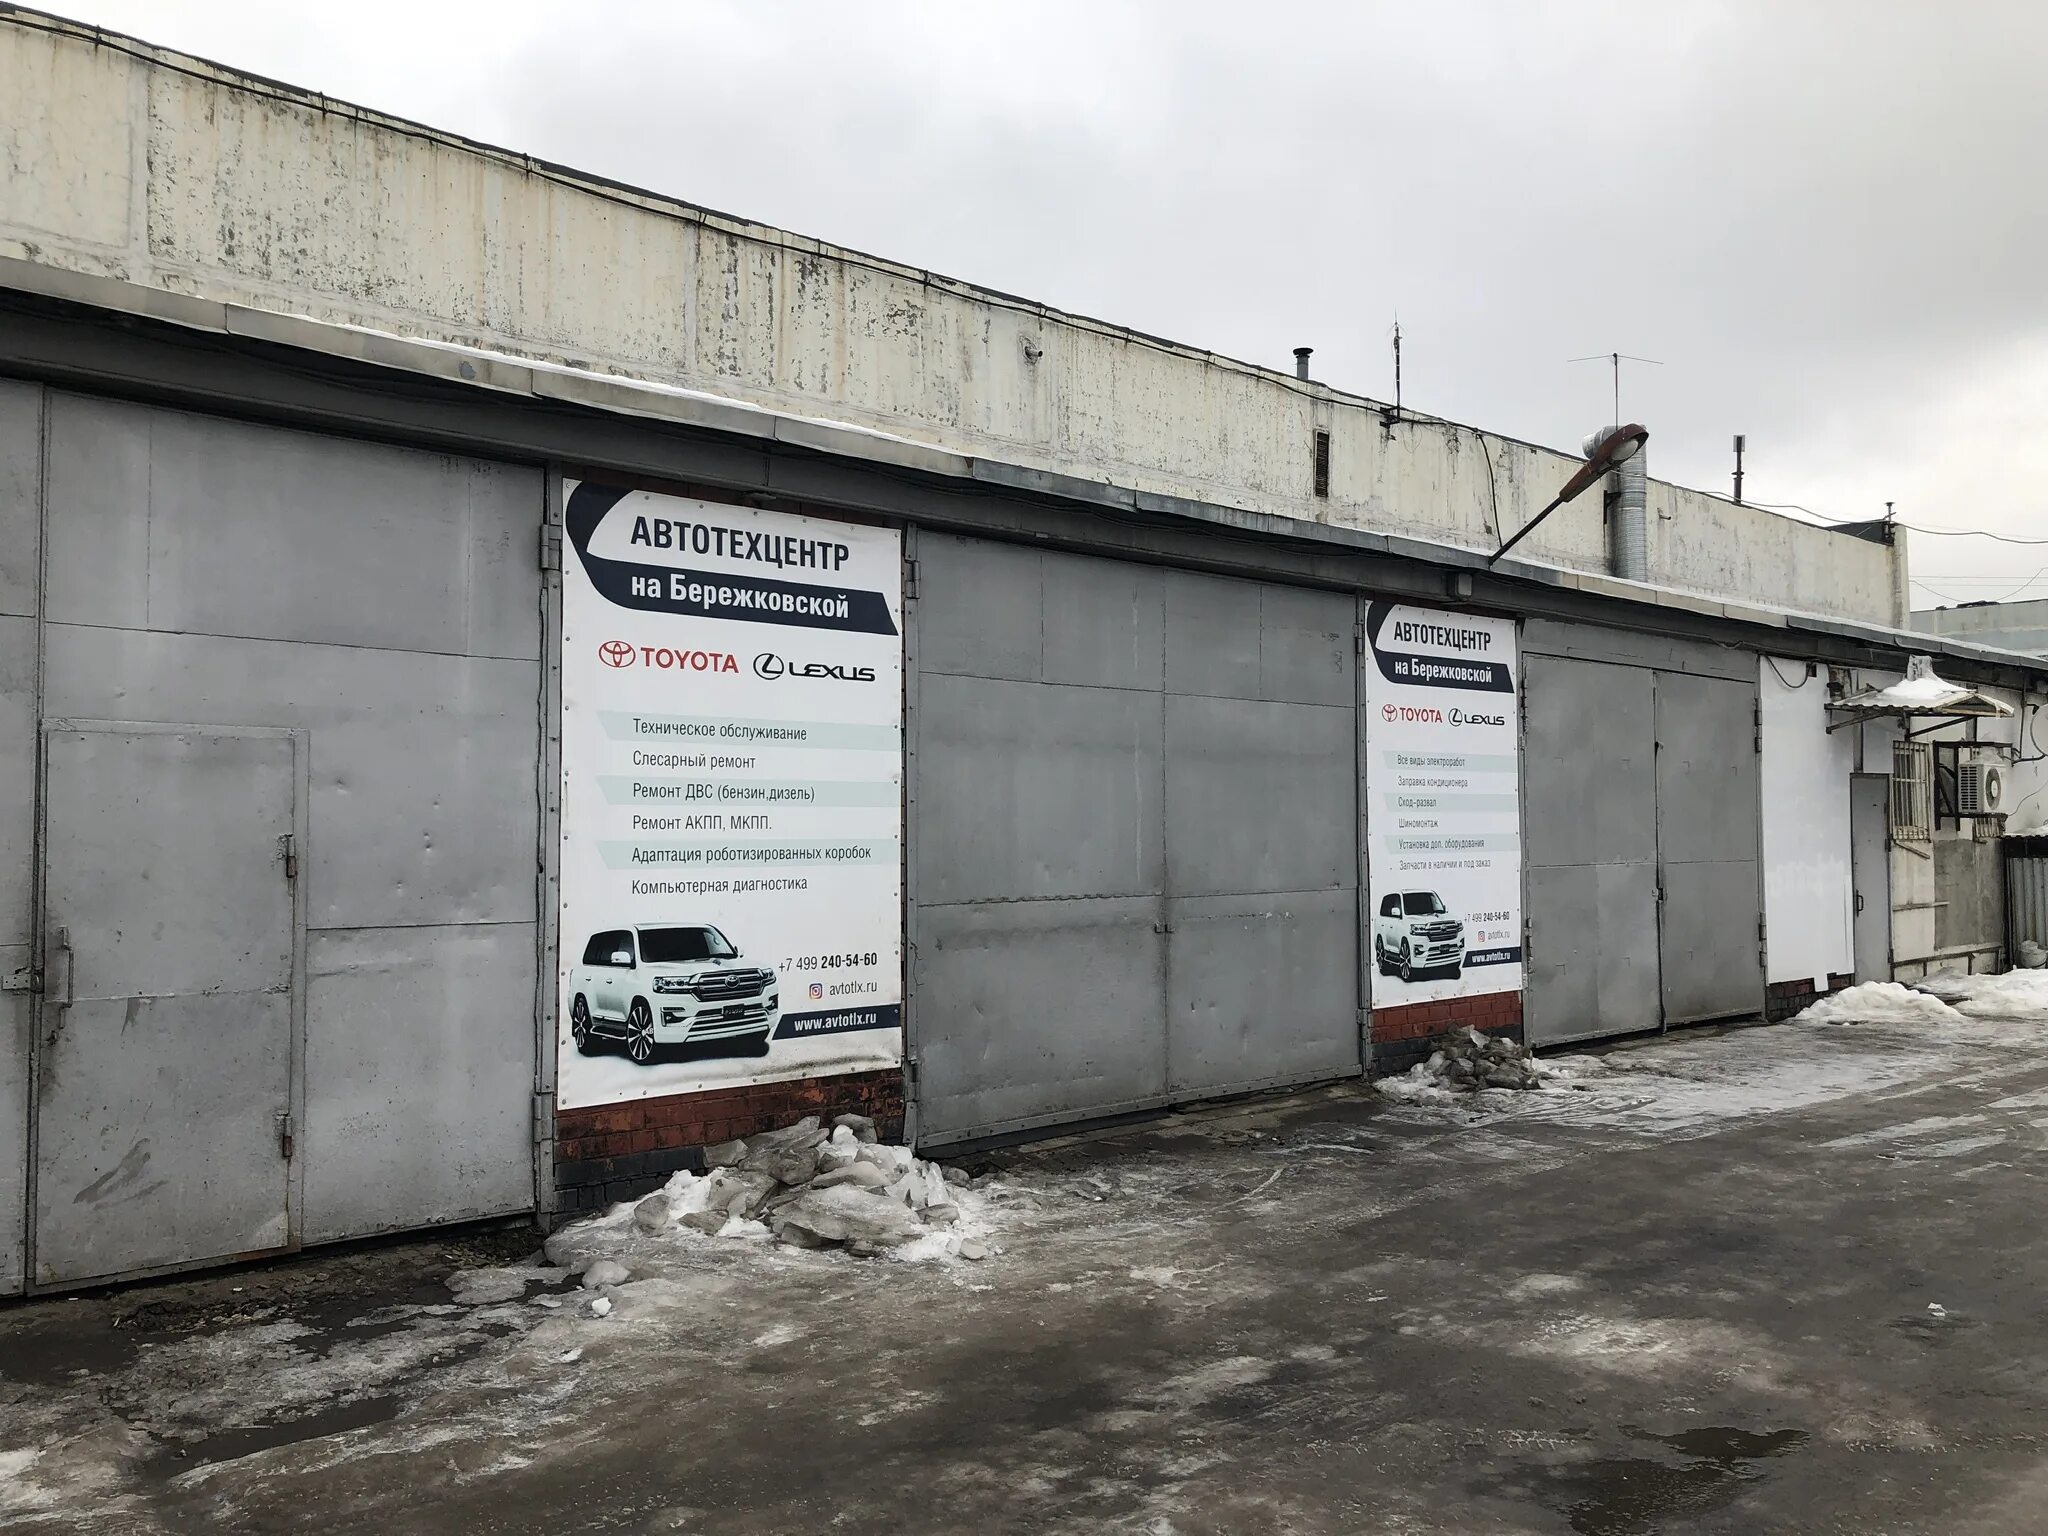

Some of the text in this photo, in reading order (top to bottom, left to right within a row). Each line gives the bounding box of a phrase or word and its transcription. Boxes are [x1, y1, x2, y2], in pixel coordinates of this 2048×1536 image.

[630, 515, 850, 571] АВТОТЕХЦЕНТР
[631, 573, 849, 618] на Бережковской
[1394, 621, 1491, 651] АВТОТЕХЦЕНТР
[640, 647, 740, 674] TOYOTA
[789, 662, 876, 682] LEXUS
[1395, 659, 1492, 683] на Бережковской
[1399, 707, 1442, 723] TOYOTA
[1464, 714, 1505, 726] LEXUS
[633, 718, 807, 741] Техническое обслуживание
[633, 750, 756, 770] Слесарный ремонт
[1398, 754, 1465, 767] Все виды электроработ
[1398, 776, 1468, 788] Заправка кондиционера
[633, 783, 815, 802] Ремонт ДВС (бензин,дизель)
[1398, 796, 1436, 808] Сход-развал
[633, 814, 772, 832] Ремонт АКПП, МКПП.
[1399, 818, 1438, 828] Шиномонтаж
[1399, 839, 1429, 849] Установка
[1445, 838, 1484, 850] оборудования
[632, 846, 871, 864] Адаптация роботизированных коробок
[1400, 860, 1427, 870] Запчасти
[1464, 860, 1474, 868] под
[1476, 860, 1491, 868] заказ
[632, 877, 808, 895] Компьютерная диагностика
[1472, 912, 1481, 922] 499
[1483, 911, 1509, 921] 240-54-60
[778, 953, 878, 973] +7 499 240-54-60
[829, 980, 877, 996] avtotlx.ru
[794, 1012, 877, 1032] www.avtotlx.ru
